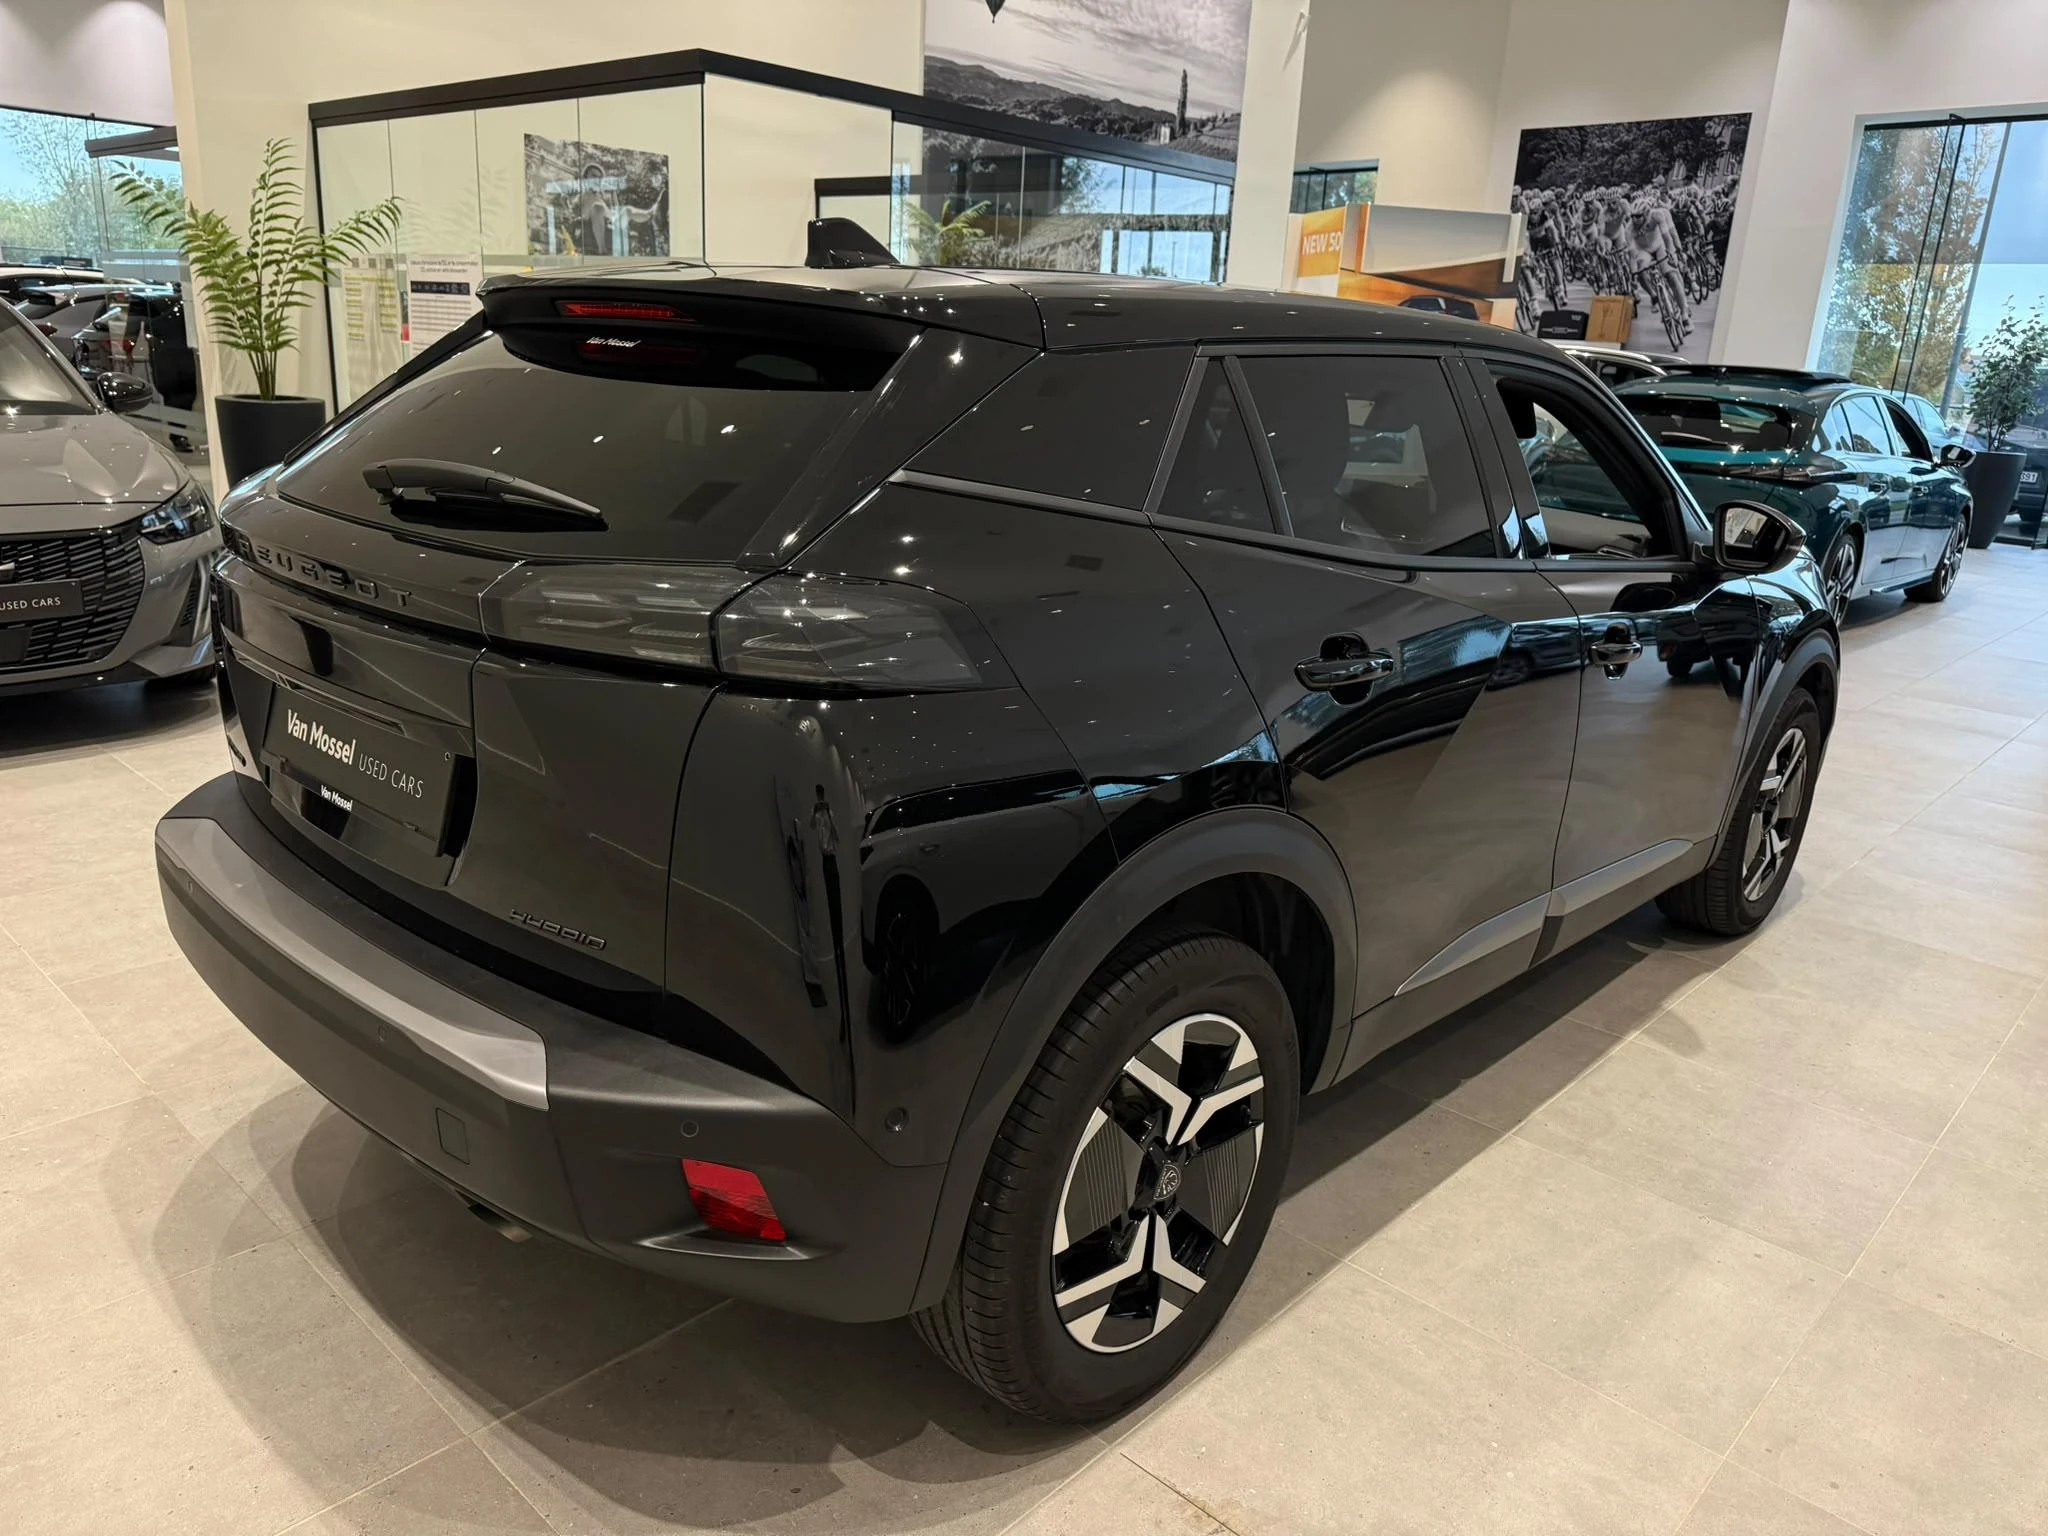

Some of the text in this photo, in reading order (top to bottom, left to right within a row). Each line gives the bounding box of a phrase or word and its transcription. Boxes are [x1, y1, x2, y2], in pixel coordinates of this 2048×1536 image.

[1302, 233, 1329, 256] NEW
[586, 336, 642, 348] Van Mossel
[236, 532, 412, 607] PEUGEOT
[31, 596, 61, 608] CARS
[287, 709, 424, 798] Van Mossel USED CARS
[321, 784, 353, 812] Van Mossel
[510, 909, 605, 950] HYBRID
